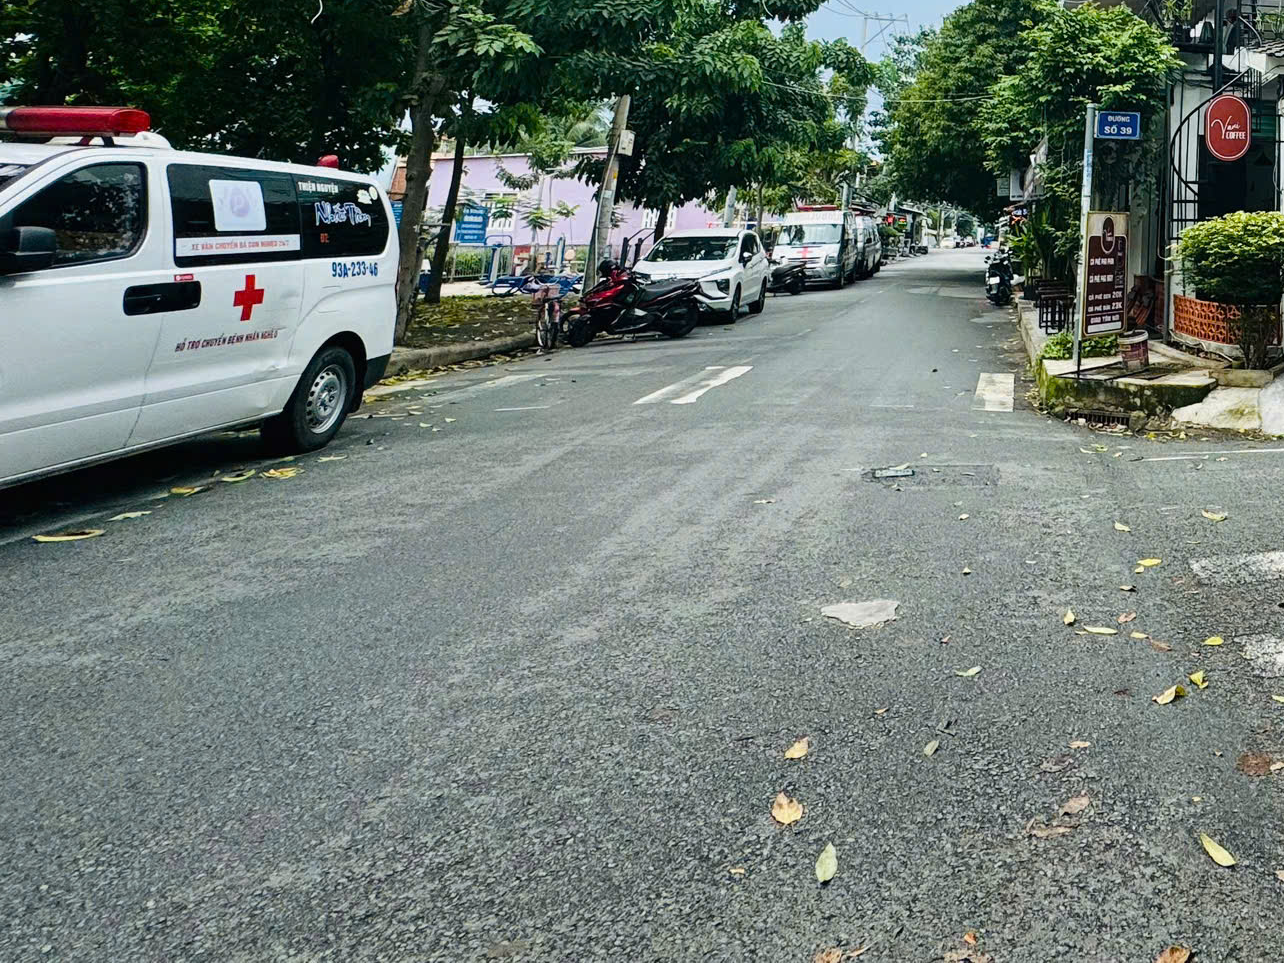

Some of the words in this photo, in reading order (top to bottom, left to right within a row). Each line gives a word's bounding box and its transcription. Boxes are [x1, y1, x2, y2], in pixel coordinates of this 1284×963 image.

[1104, 124, 1118, 134] SỐ
[1120, 126, 1133, 135] 39
[1210, 115, 1241, 140] Vani
[1225, 131, 1247, 140] COFFEE
[332, 261, 379, 278] 93A-233-46
[1112, 290, 1123, 299] 20K
[1111, 301, 1123, 310] 23K
